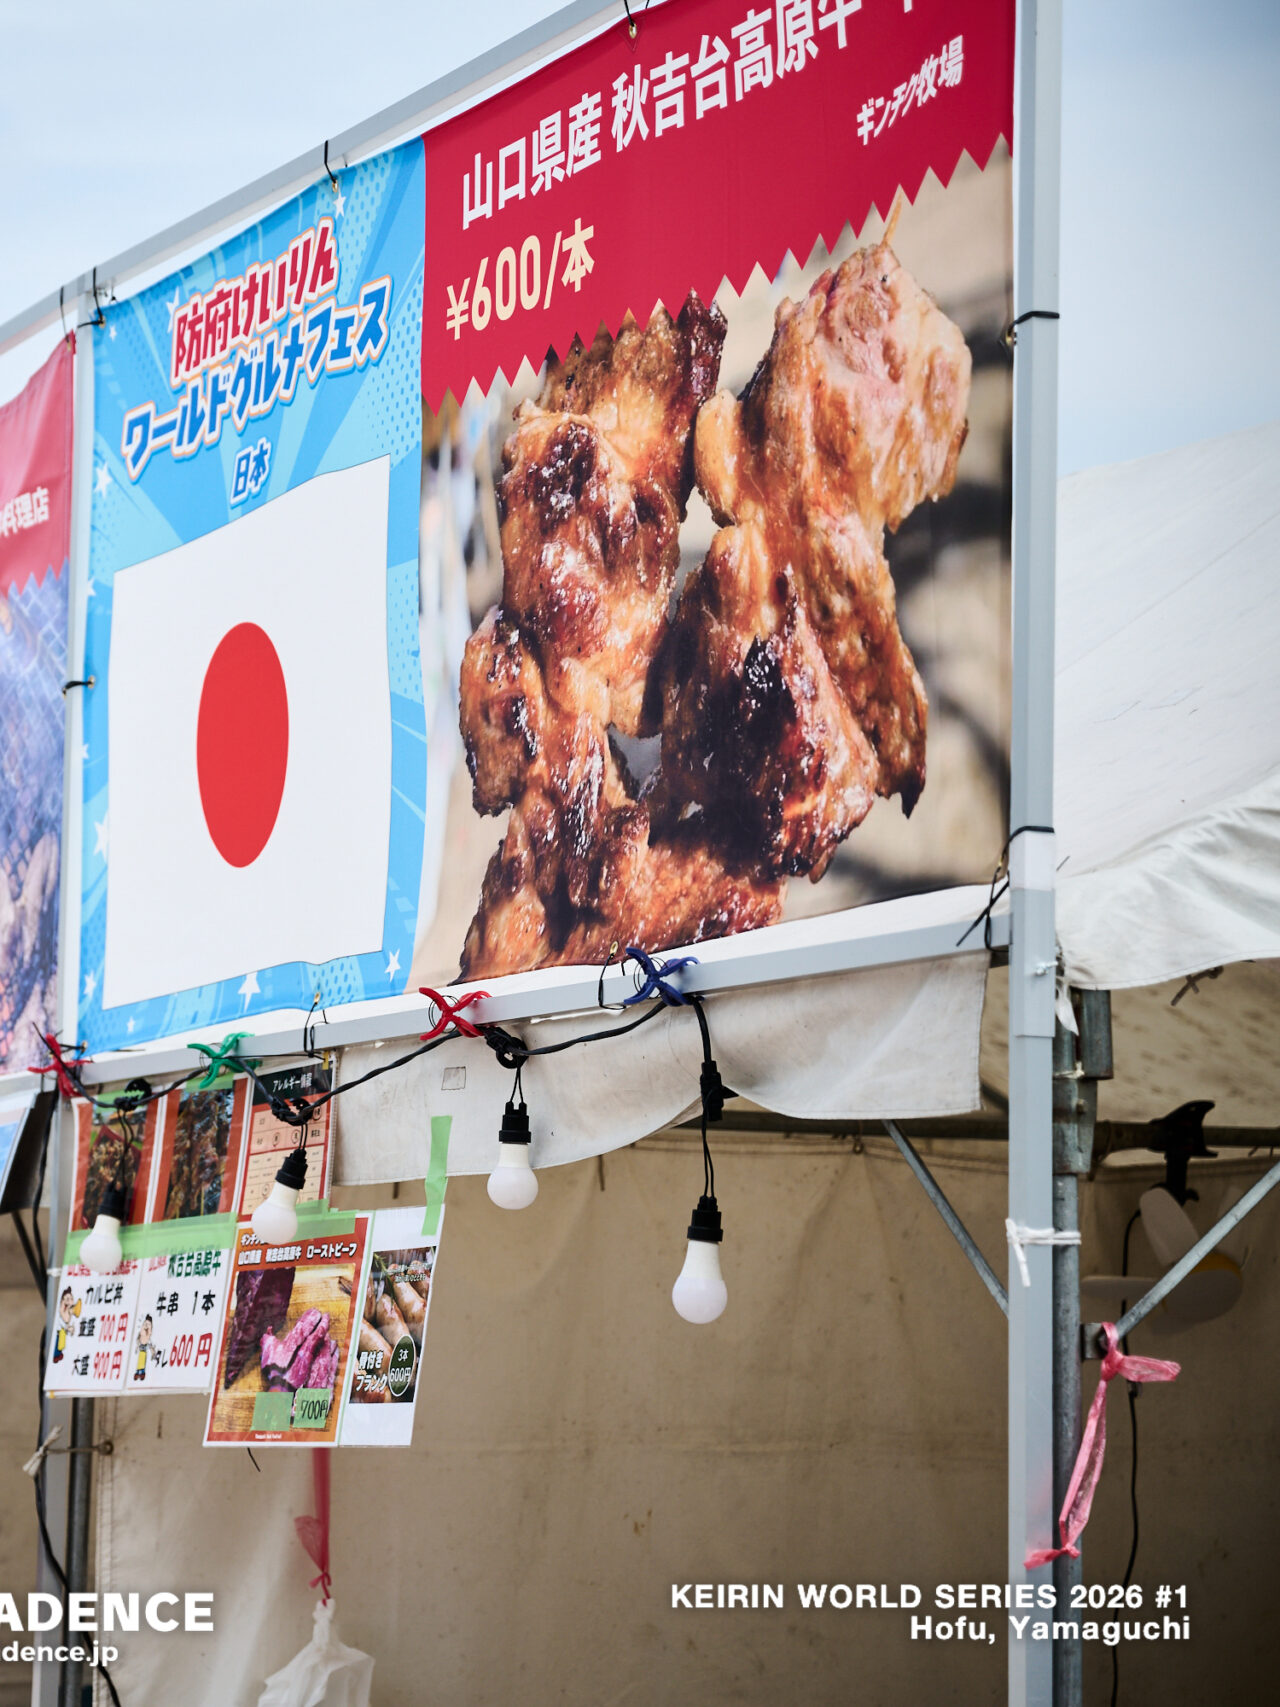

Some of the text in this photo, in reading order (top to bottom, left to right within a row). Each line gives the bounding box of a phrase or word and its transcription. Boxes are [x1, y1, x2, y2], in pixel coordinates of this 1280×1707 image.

[856, 35, 964, 146] ギンチク牧場
[462, 0, 862, 230] 山口県産 秋吉台高原牛
[446, 218, 595, 340] ¥600/本
[173, 221, 338, 385] 防府けいりん
[123, 279, 391, 477] ワールドグルメフェス
[231, 439, 269, 503] 日本
[306, 1242, 358, 1260] ローストビーフ
[84, 1282, 124, 1305] カルビ丼
[156, 1292, 179, 1316] 牛串
[98, 1313, 129, 1343] 700円
[93, 1350, 123, 1380] 900円
[170, 1332, 213, 1368] 600円
[358, 1349, 384, 1371] 骨付き
[398, 1348, 409, 1362] 3本
[355, 1373, 388, 1393] フランク
[389, 1367, 412, 1384] 600円
[300, 1399, 330, 1422] 700円
